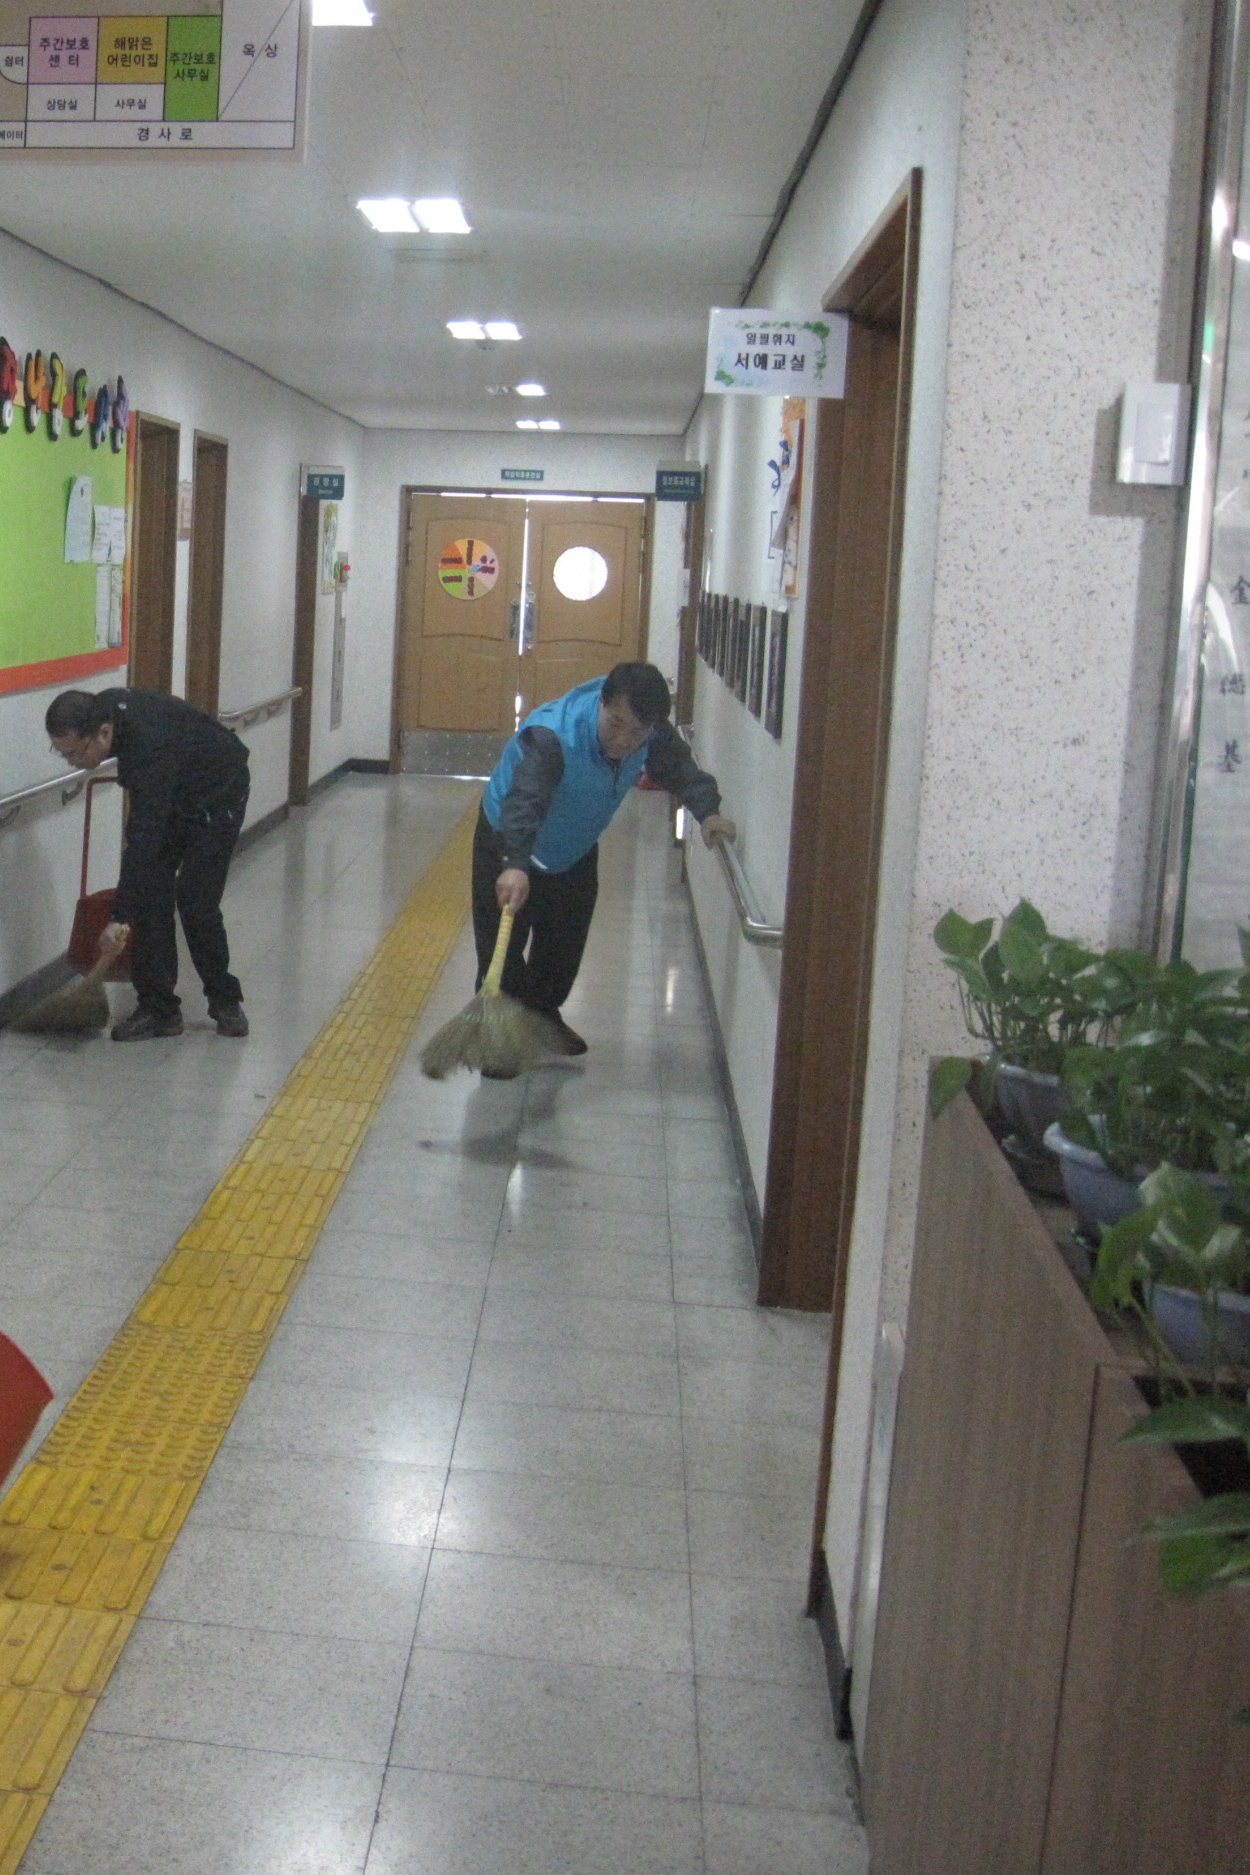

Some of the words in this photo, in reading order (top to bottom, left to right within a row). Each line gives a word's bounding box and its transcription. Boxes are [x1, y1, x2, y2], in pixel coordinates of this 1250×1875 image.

[39, 37, 90, 51] 주간보호
[113, 37, 153, 51] 해맑은
[4, 55, 25, 68] 쉼터
[107, 54, 159, 68] 어린이집
[169, 52, 217, 66] 주간보호
[174, 68, 210, 82] 사무실
[46, 99, 78, 111] 상담실
[114, 98, 147, 110] 사무실
[746, 332, 796, 347] 일필휘지
